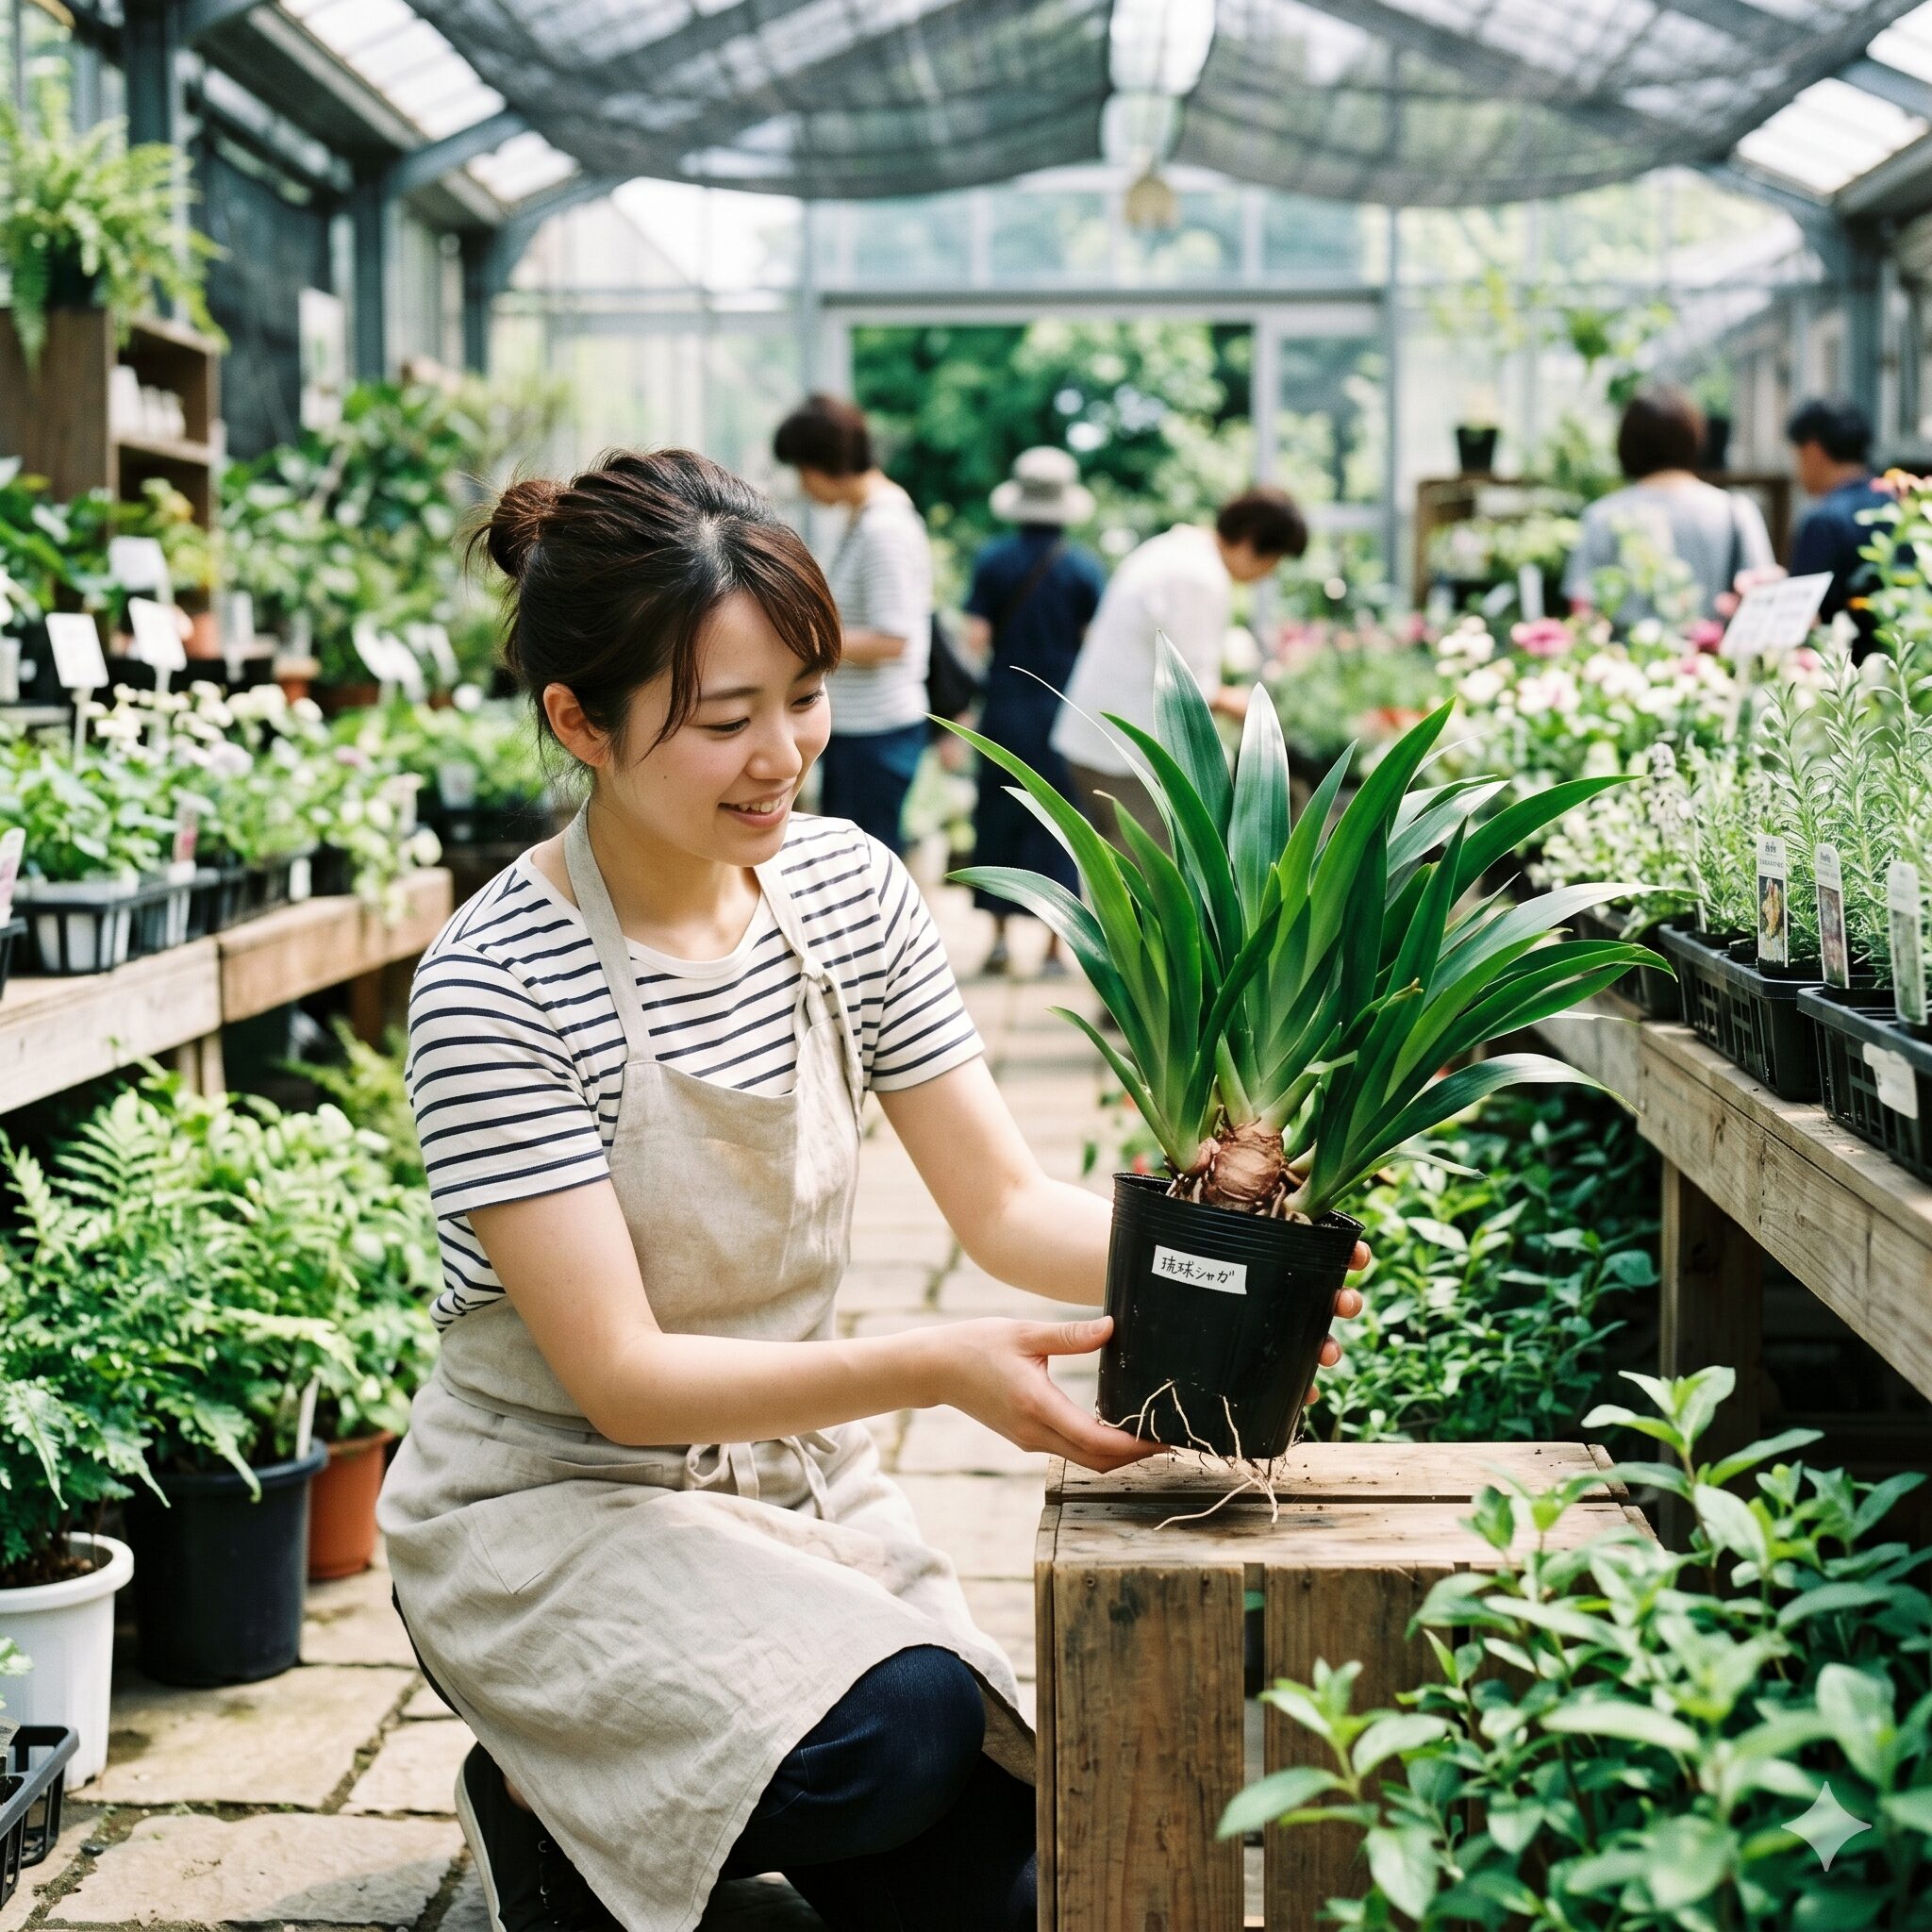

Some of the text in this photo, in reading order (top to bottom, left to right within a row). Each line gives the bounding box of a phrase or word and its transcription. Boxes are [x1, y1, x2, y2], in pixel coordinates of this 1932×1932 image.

[1160, 1256, 1235, 1283] 琉球シャガ
